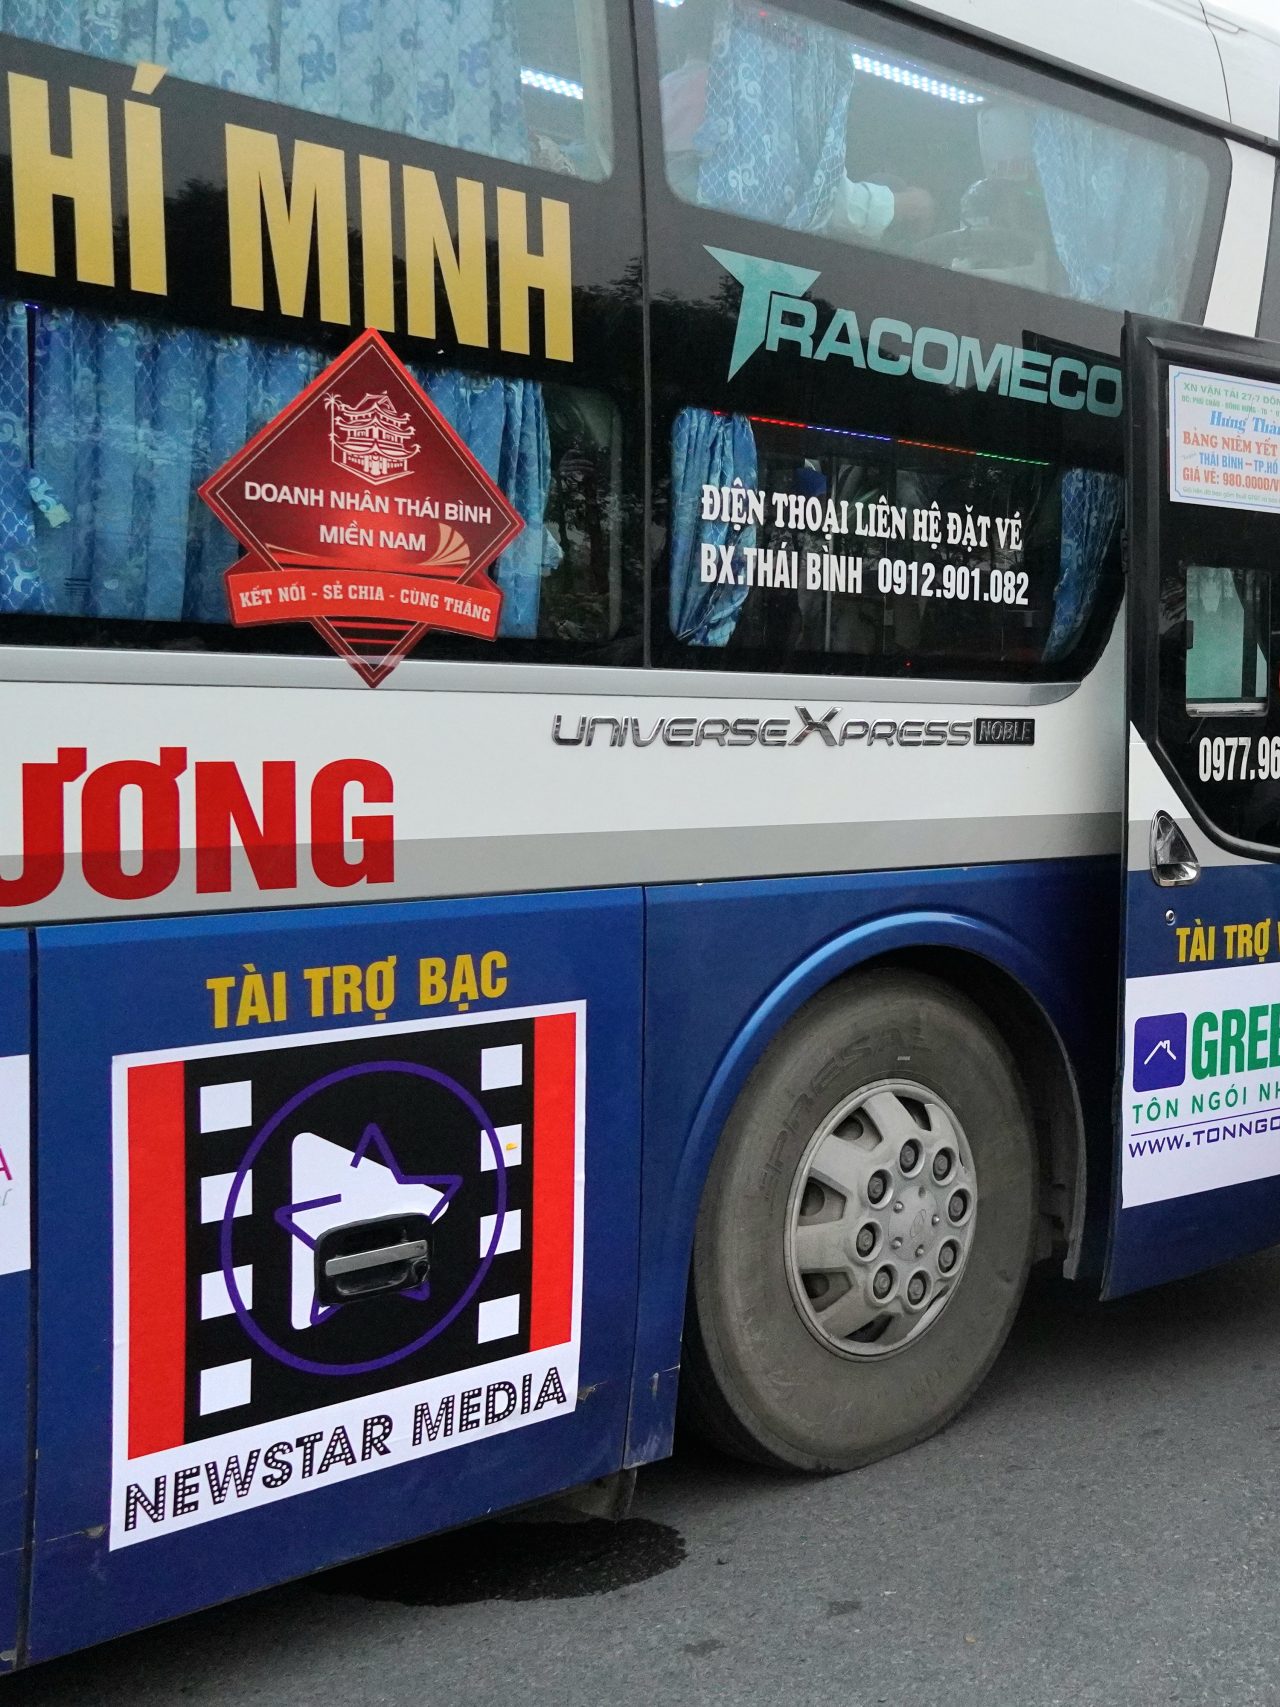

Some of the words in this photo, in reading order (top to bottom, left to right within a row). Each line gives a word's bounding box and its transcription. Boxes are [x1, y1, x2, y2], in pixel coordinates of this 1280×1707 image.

[8, 62, 167, 295] HÍ
[225, 122, 574, 362] MINH
[702, 244, 1122, 418] TRACOMECO
[1183, 427, 1218, 449] BẢNG
[1182, 466, 1200, 483] GIÁ
[244, 482, 324, 508] DOANH
[330, 490, 389, 514] NHÂN
[394, 497, 440, 519] THÁI
[444, 500, 491, 524] BÌNH
[701, 477, 765, 531] ĐIỆN
[772, 492, 849, 540] THOẠI
[855, 495, 907, 539] LIÊN
[912, 500, 942, 550] HỆ
[947, 504, 991, 552] ĐẶT
[995, 511, 1023, 550] VÉ
[319, 520, 374, 548] MIỀN
[380, 530, 426, 551] NAM
[700, 542, 798, 589] BX.THÁI
[806, 546, 863, 594] BÌNH
[877, 558, 1030, 605] 0912.901.082
[240, 583, 272, 608] KẾT
[278, 582, 306, 602] NỐI
[323, 580, 343, 600] SẺ
[348, 585, 384, 601] CHIA
[400, 587, 439, 608] CÙNG
[444, 597, 491, 622] THẮNG
[980, 720, 1032, 743] NOBLE
[1176, 918, 1215, 962] TÀI
[1223, 918, 1271, 963] TRỢ
[206, 963, 287, 1029] TÀI
[303, 955, 397, 1021] TRỢ
[419, 950, 508, 1012] BẠC
[1132, 1097, 1179, 1124] TÔN
[1191, 1084, 1247, 1114] NGÓI
[124, 1414, 393, 1532] NEWSTAR
[411, 1366, 567, 1446] MEDIA
